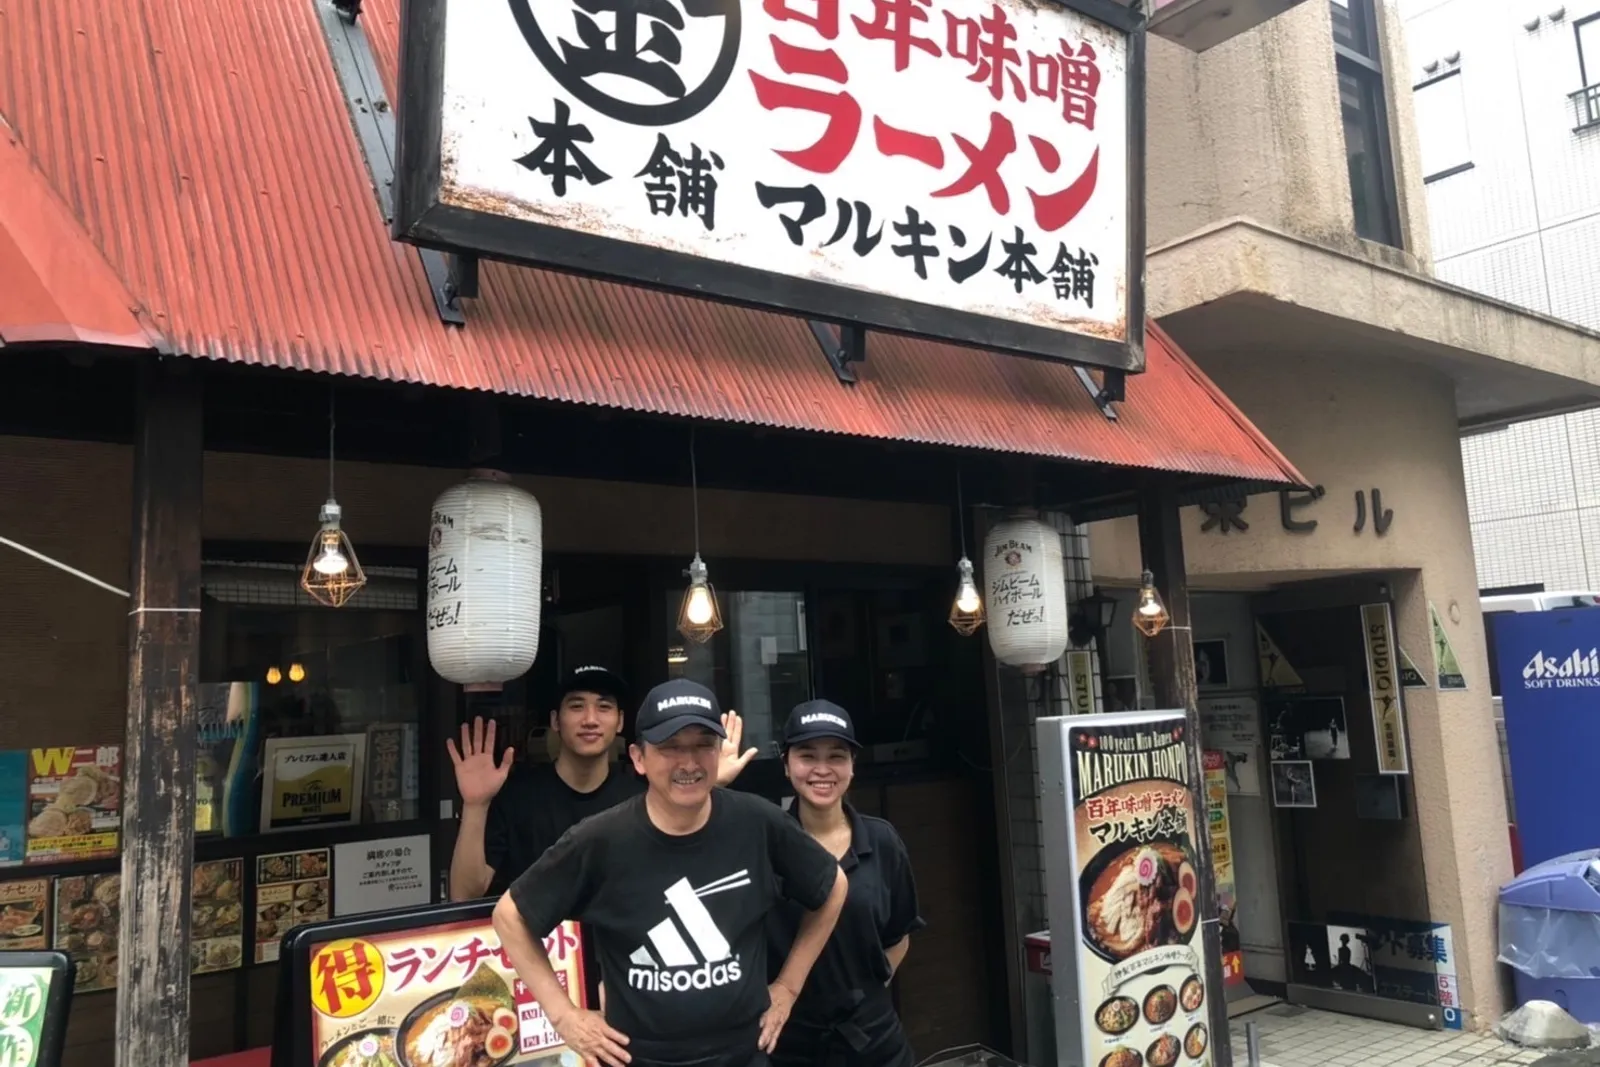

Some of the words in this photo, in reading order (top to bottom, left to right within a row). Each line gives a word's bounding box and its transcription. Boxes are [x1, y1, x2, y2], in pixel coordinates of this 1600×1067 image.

[747, 34, 1100, 232] ラーメン
[513, 98, 725, 231] 本舗
[755, 180, 1099, 309] マルキン本舗
[1370, 623, 1392, 691] STUDIO
[1522, 646, 1600, 679] Asahi
[1523, 678, 1553, 689] SOFT
[1556, 677, 1600, 688] DRINKS
[282, 788, 342, 807] PREMIUM
[1076, 750, 1149, 800] MARUKIN
[1151, 741, 1188, 785] HONPO
[1086, 790, 1186, 819] 百年味噌ラーメン
[316, 942, 376, 1014] 得
[628, 961, 742, 992] misodas
